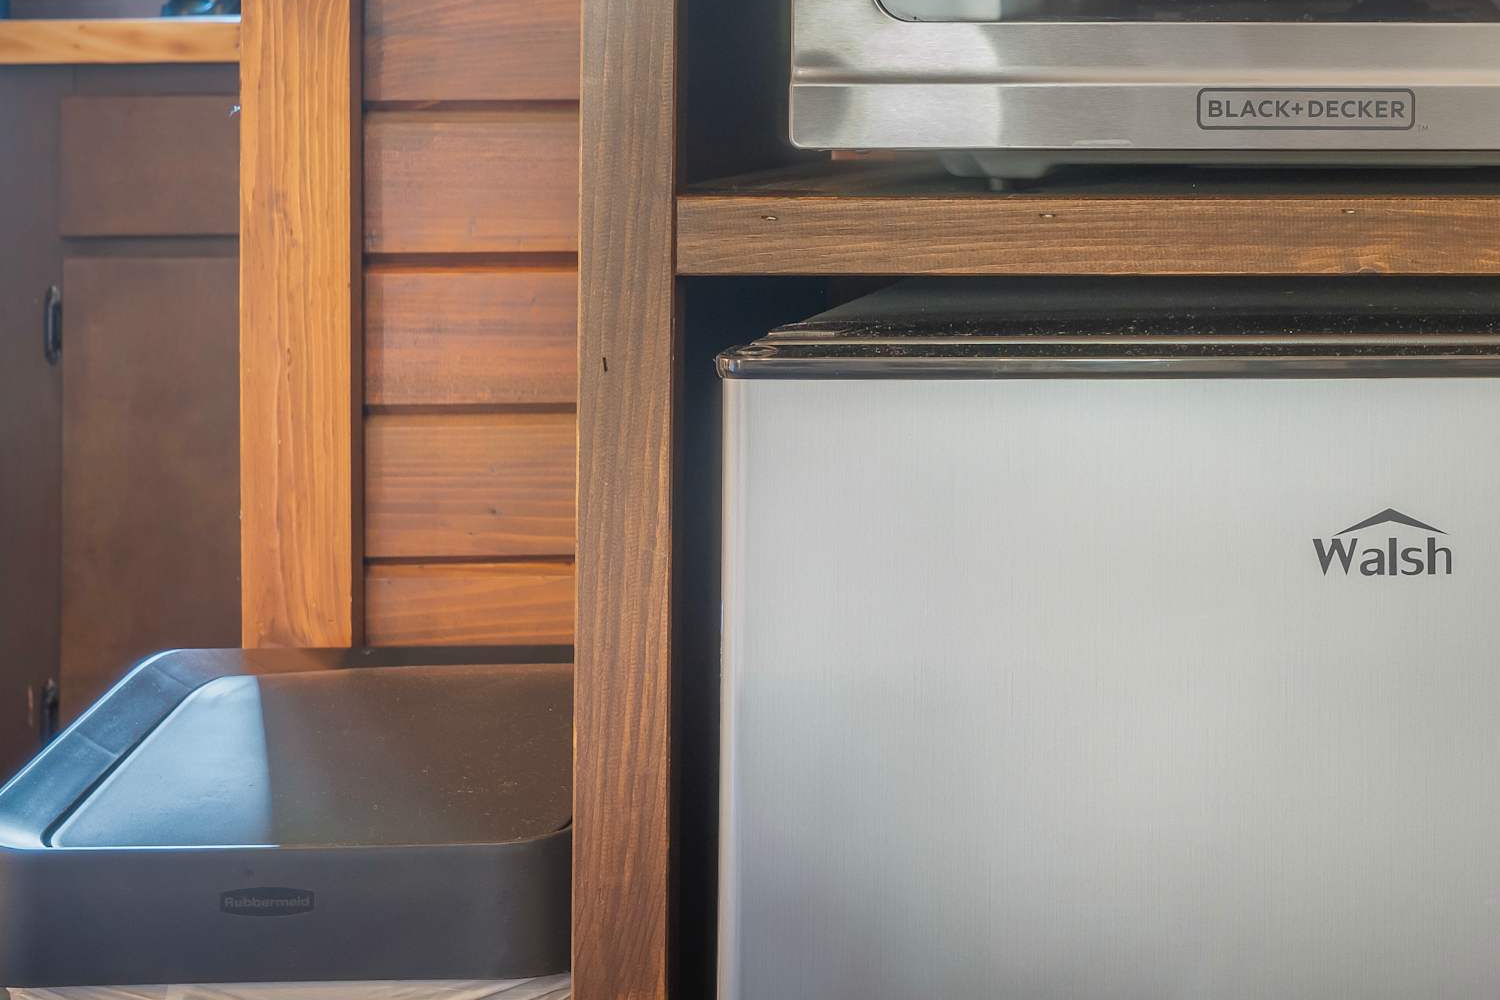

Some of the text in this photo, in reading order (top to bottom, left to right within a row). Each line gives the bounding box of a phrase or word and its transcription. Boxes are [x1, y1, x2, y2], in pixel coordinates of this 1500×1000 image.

[1207, 100, 1405, 119] BLACK+DECKER
[1312, 537, 1452, 577] Walsh
[224, 896, 310, 908] Rubbermaid
